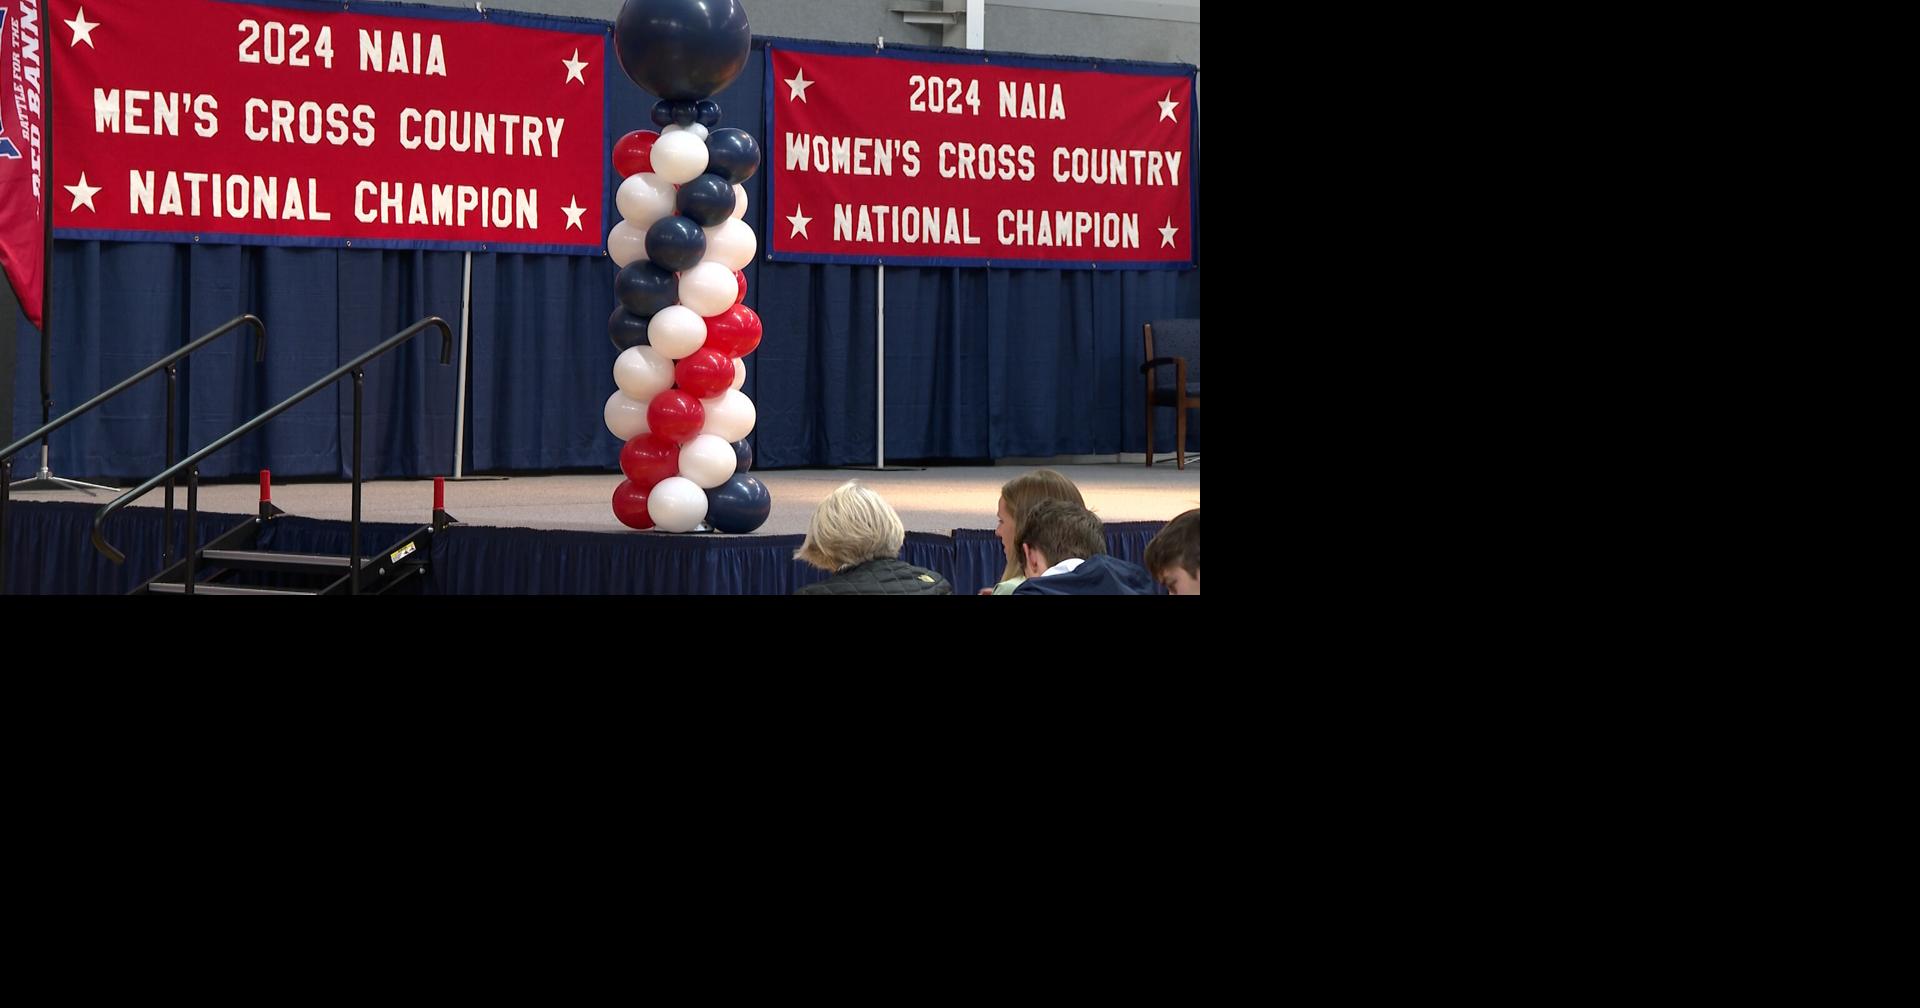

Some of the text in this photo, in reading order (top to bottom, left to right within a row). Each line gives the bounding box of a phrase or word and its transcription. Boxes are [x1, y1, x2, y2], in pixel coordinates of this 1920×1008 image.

[20, 0, 41, 119] BANN
[238, 20, 447, 77] 2024 NAIA
[11, 16, 30, 141] BATTLE FOR THE
[909, 75, 1066, 120] 2024 NAIA
[94, 88, 565, 158] MEN'S CROSS COUNTRY
[785, 132, 1182, 186] WOMEN'S CROSS COUNTRY
[129, 170, 538, 229] NATIONAL CHAMPION
[833, 204, 1140, 249] NATIONAL CHAMPION
